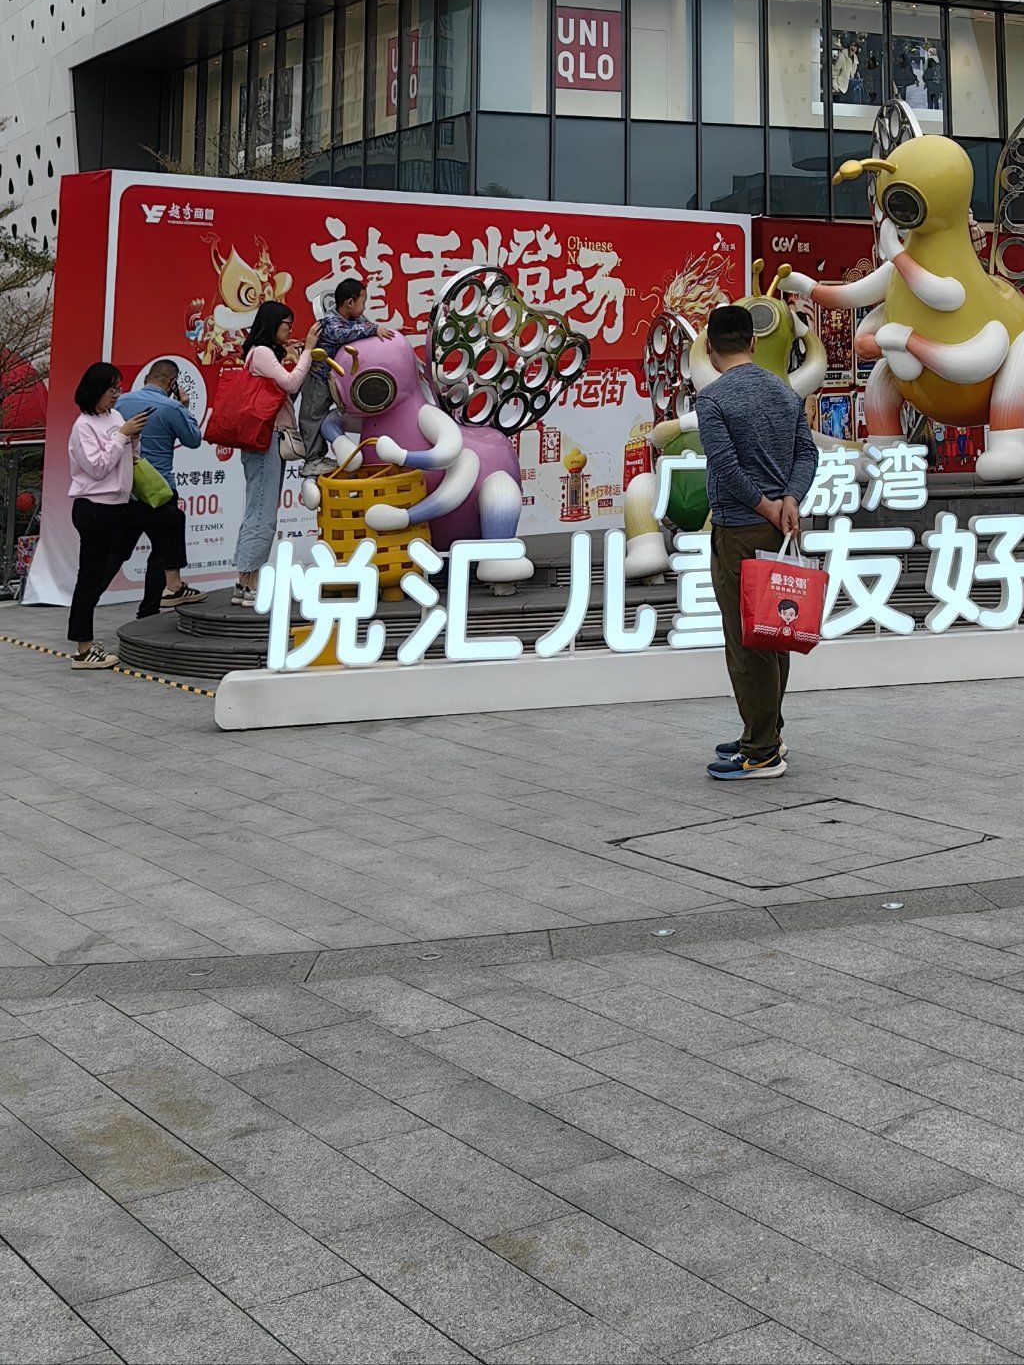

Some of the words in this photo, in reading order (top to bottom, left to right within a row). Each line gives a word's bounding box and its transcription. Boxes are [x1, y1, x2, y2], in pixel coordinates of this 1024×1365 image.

[557, 17, 609, 48] UNI
[557, 50, 614, 83] QLO
[567, 236, 613, 251] Chinese
[772, 236, 795, 253] CGV
[174, 469, 225, 486] 饮零售券
[190, 523, 224, 532] TEENMIX
